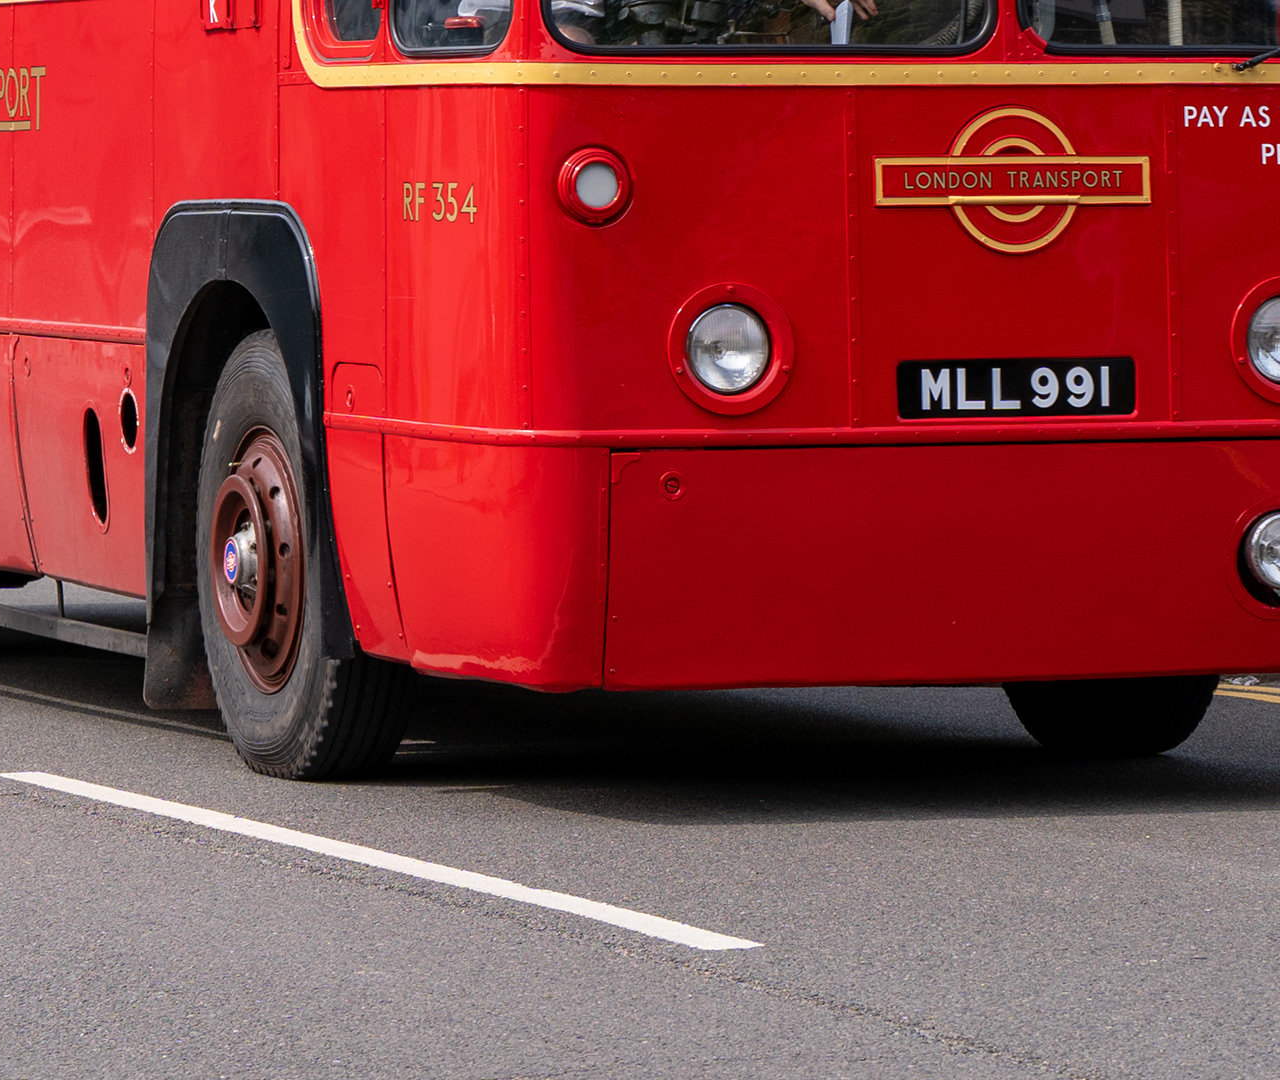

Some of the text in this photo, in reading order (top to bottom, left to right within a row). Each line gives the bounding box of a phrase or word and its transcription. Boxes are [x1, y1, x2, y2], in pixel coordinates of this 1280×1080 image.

[1183, 105, 1228, 127] PAY
[1239, 105, 1271, 127] AS
[904, 170, 1122, 190] LONDON TRANSPORT
[403, 182, 477, 224] RF 354
[921, 365, 1110, 410] MLL 991
